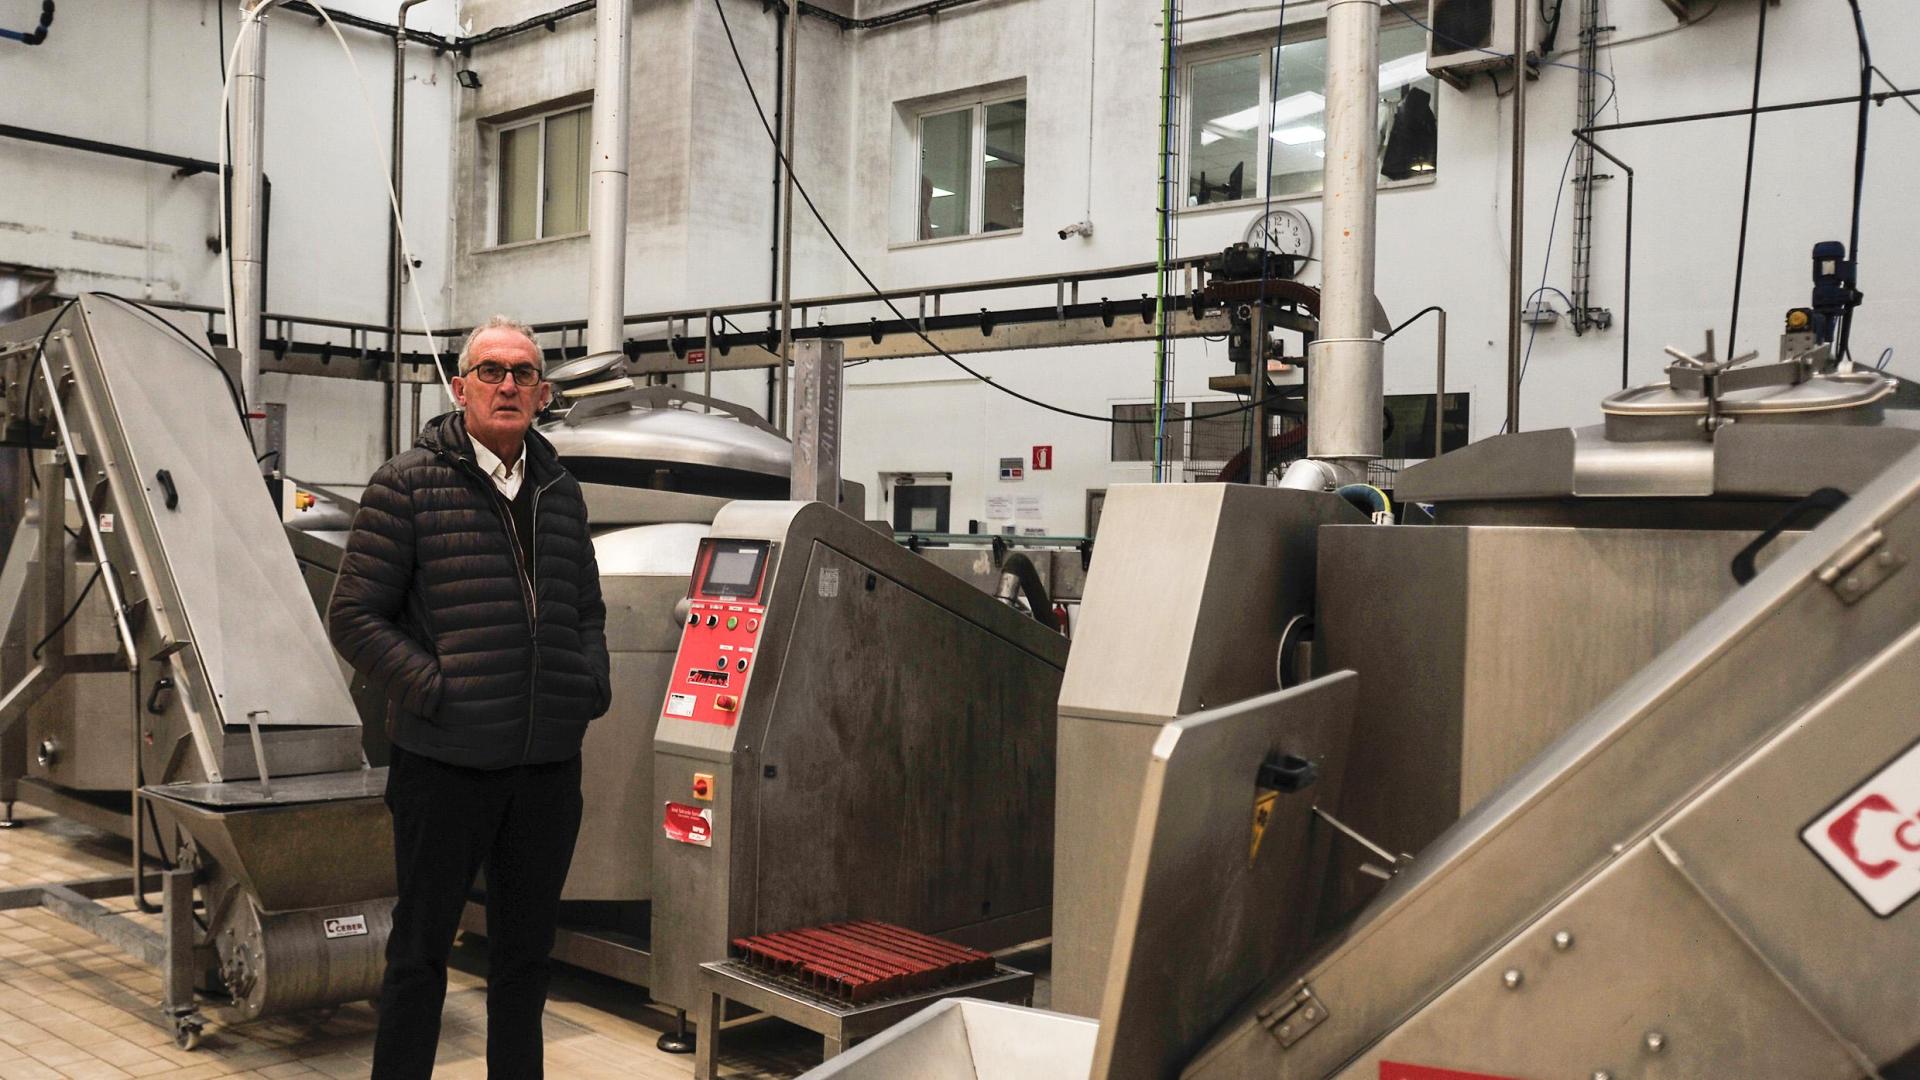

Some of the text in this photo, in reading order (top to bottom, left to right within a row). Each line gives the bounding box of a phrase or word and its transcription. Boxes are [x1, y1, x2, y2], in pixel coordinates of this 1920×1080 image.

[1274, 216, 1282, 226] 12
[1256, 230, 1264, 239] 10
[1292, 226, 1298, 236] 2
[1295, 238, 1301, 247] 3
[336, 923, 363, 932] CEBER
